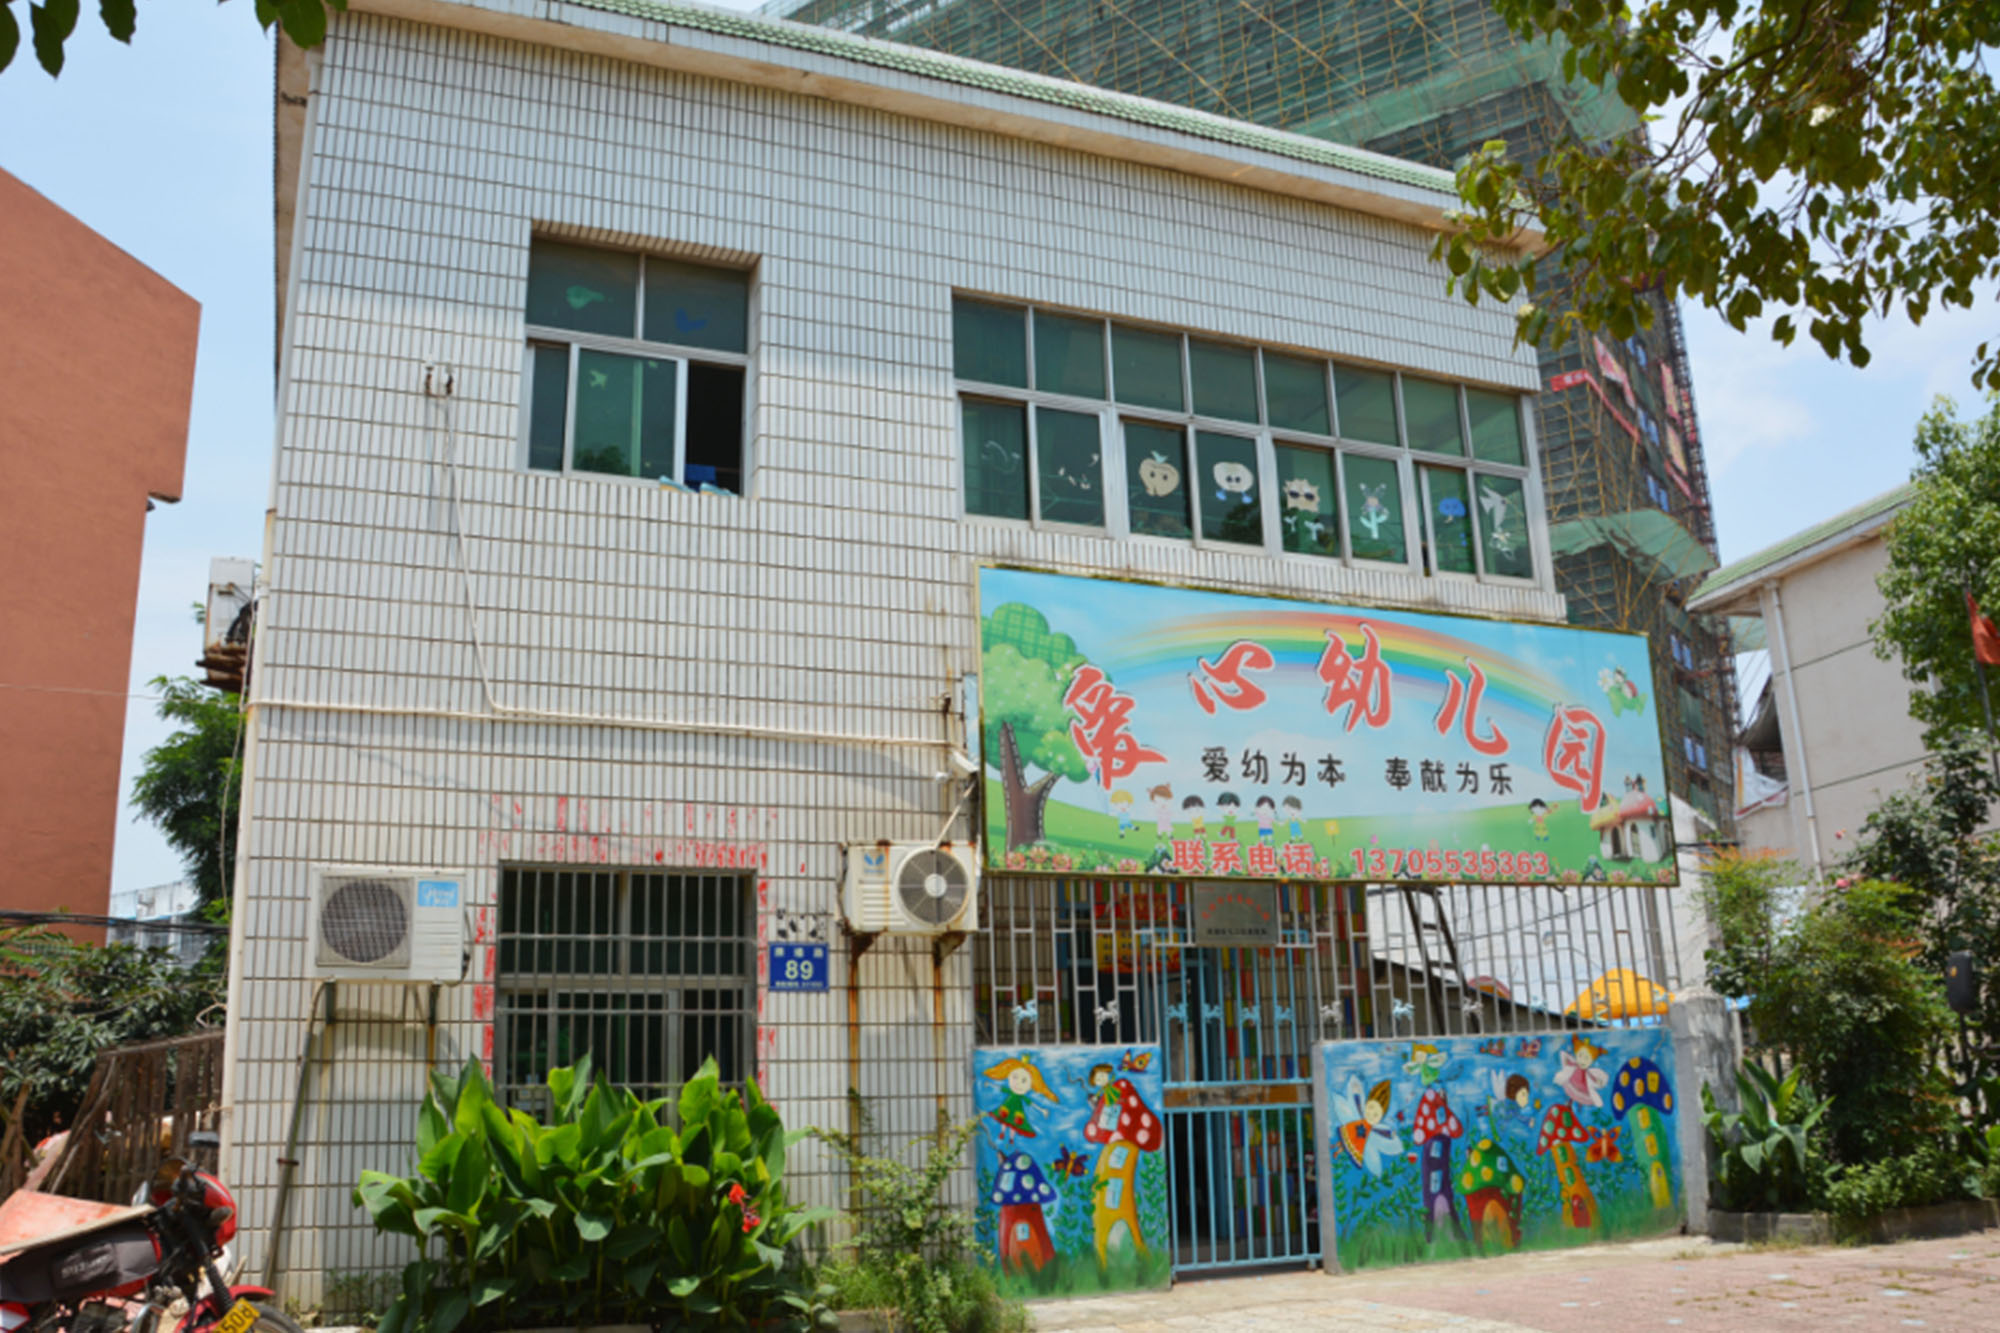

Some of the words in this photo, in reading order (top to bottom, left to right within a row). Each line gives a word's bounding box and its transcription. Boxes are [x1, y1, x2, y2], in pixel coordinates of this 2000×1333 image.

[1201, 746, 1346, 789] 爱幼为本
[1384, 756, 1514, 796] 奉献为乐
[1350, 847, 1551, 877] 13705535363
[785, 959, 814, 981] 89
